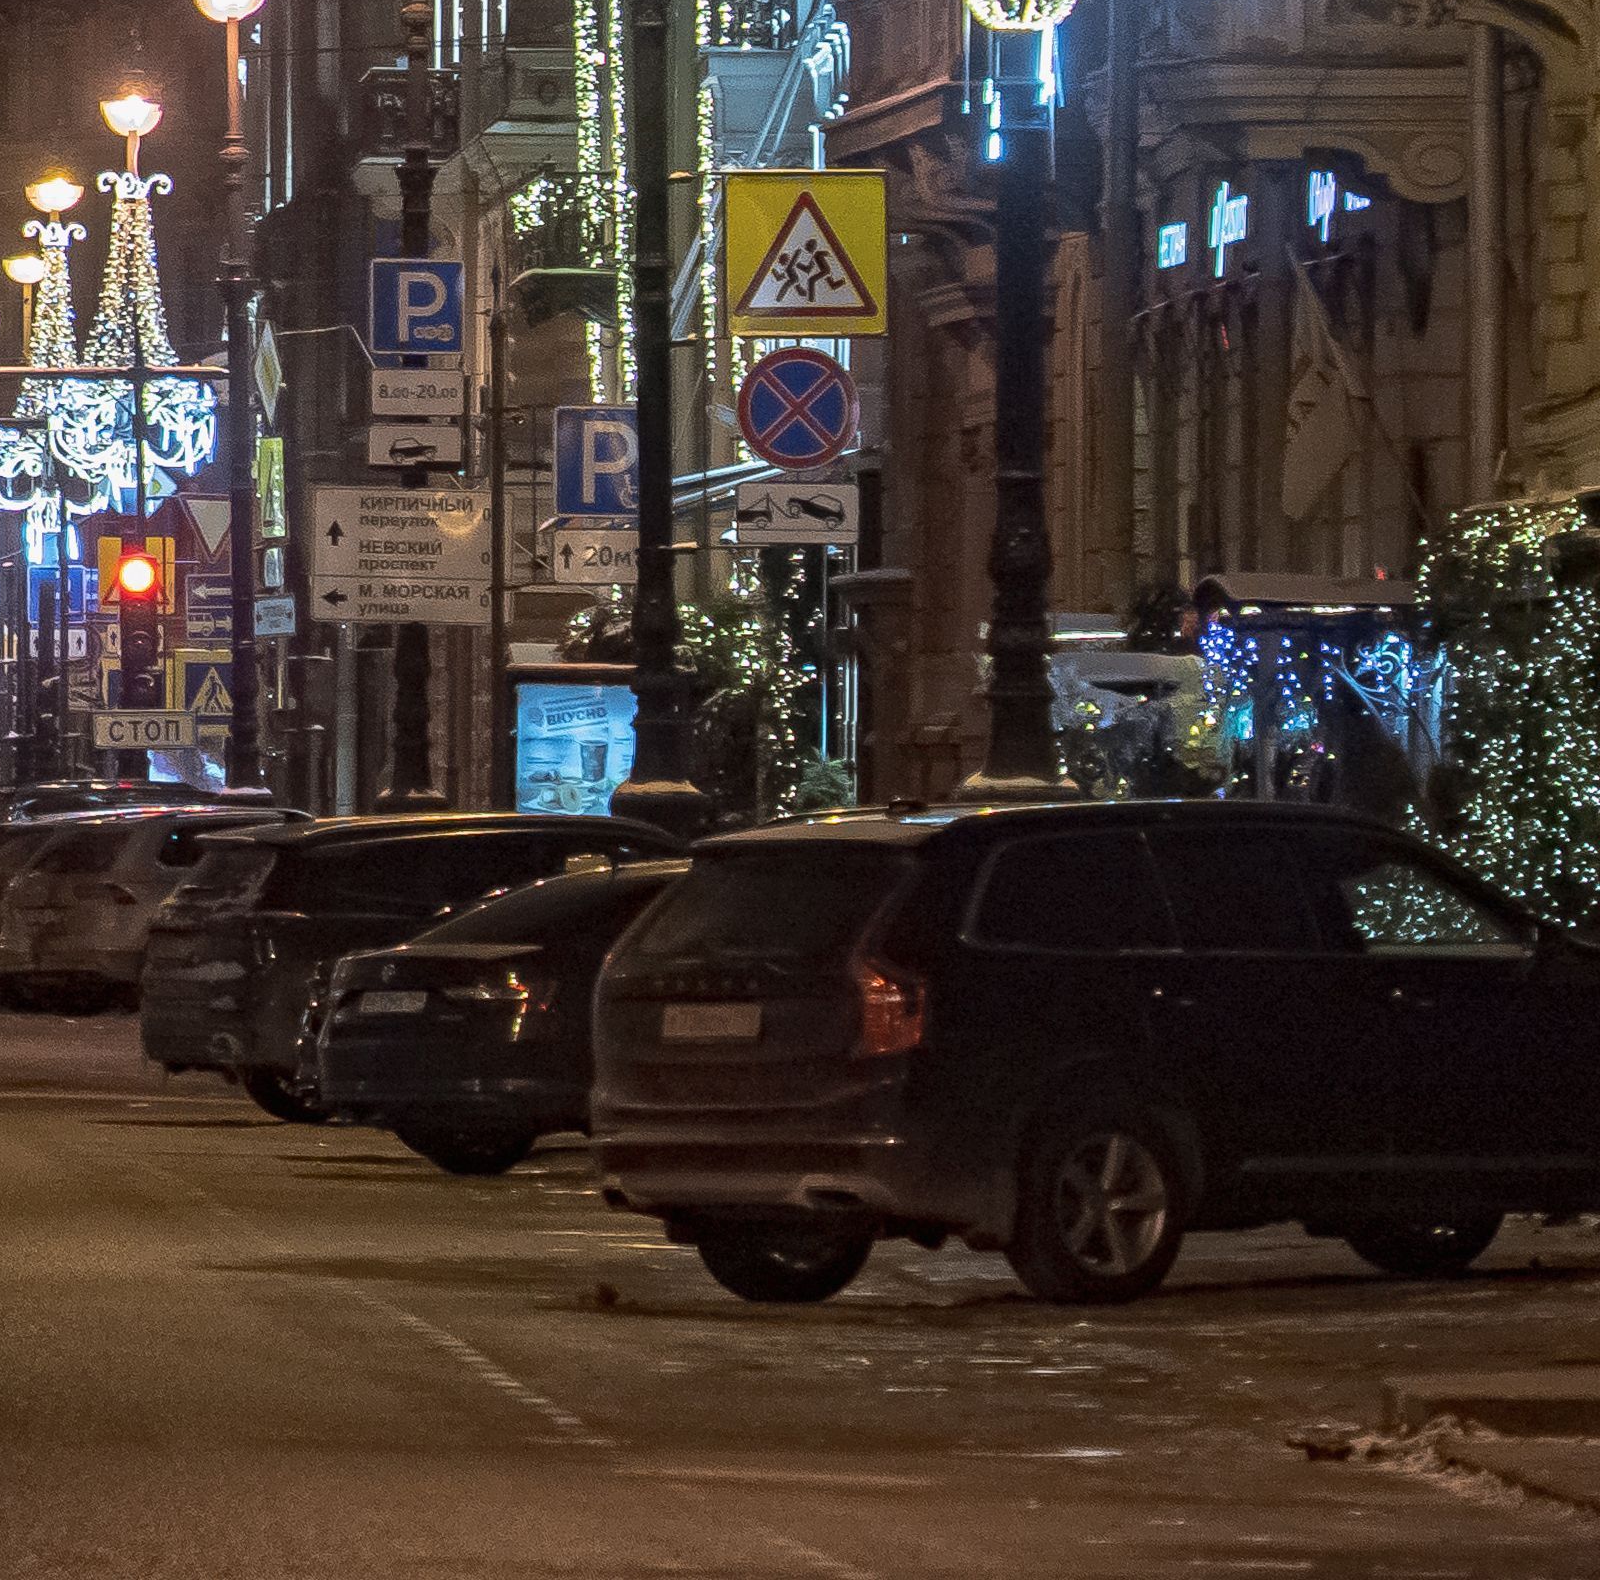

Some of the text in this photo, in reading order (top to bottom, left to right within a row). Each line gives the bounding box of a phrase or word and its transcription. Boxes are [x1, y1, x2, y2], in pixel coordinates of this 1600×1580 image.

[360, 496, 473, 512] КИРПИЧНЫЙ
[359, 515, 439, 529] переулок
[359, 538, 443, 555] НЕВСКИЙ
[358, 559, 438, 571] проспект
[359, 585, 471, 599] М. МОРСКАЯ
[358, 603, 410, 617] улица
[109, 719, 180, 742] СТОП
